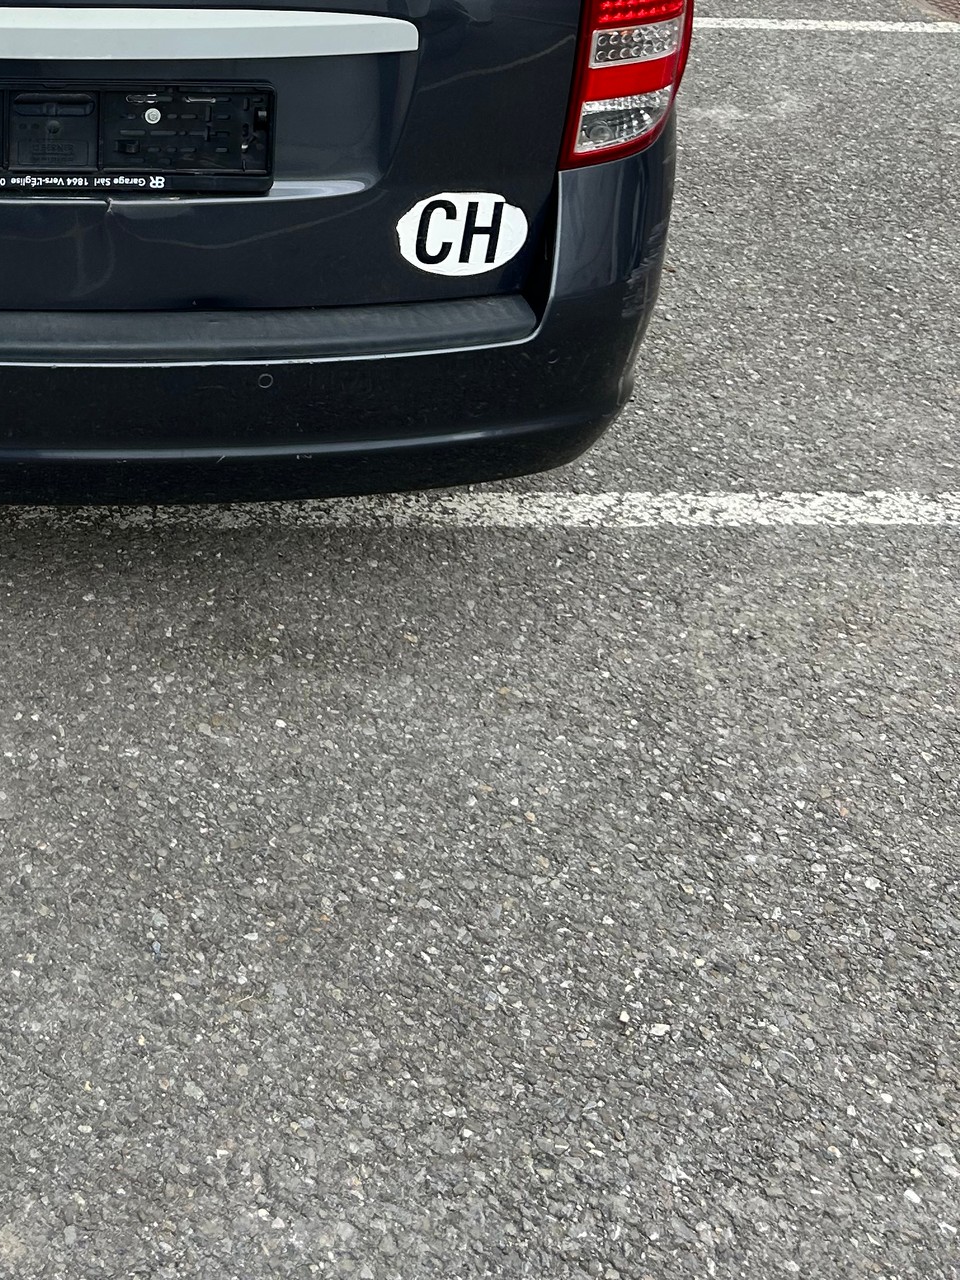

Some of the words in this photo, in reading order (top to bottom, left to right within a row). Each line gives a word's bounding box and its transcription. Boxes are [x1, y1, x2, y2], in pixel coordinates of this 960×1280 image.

[66, 177, 89, 186] 1864
[113, 175, 146, 187] Garage
[415, 199, 505, 265] CH
